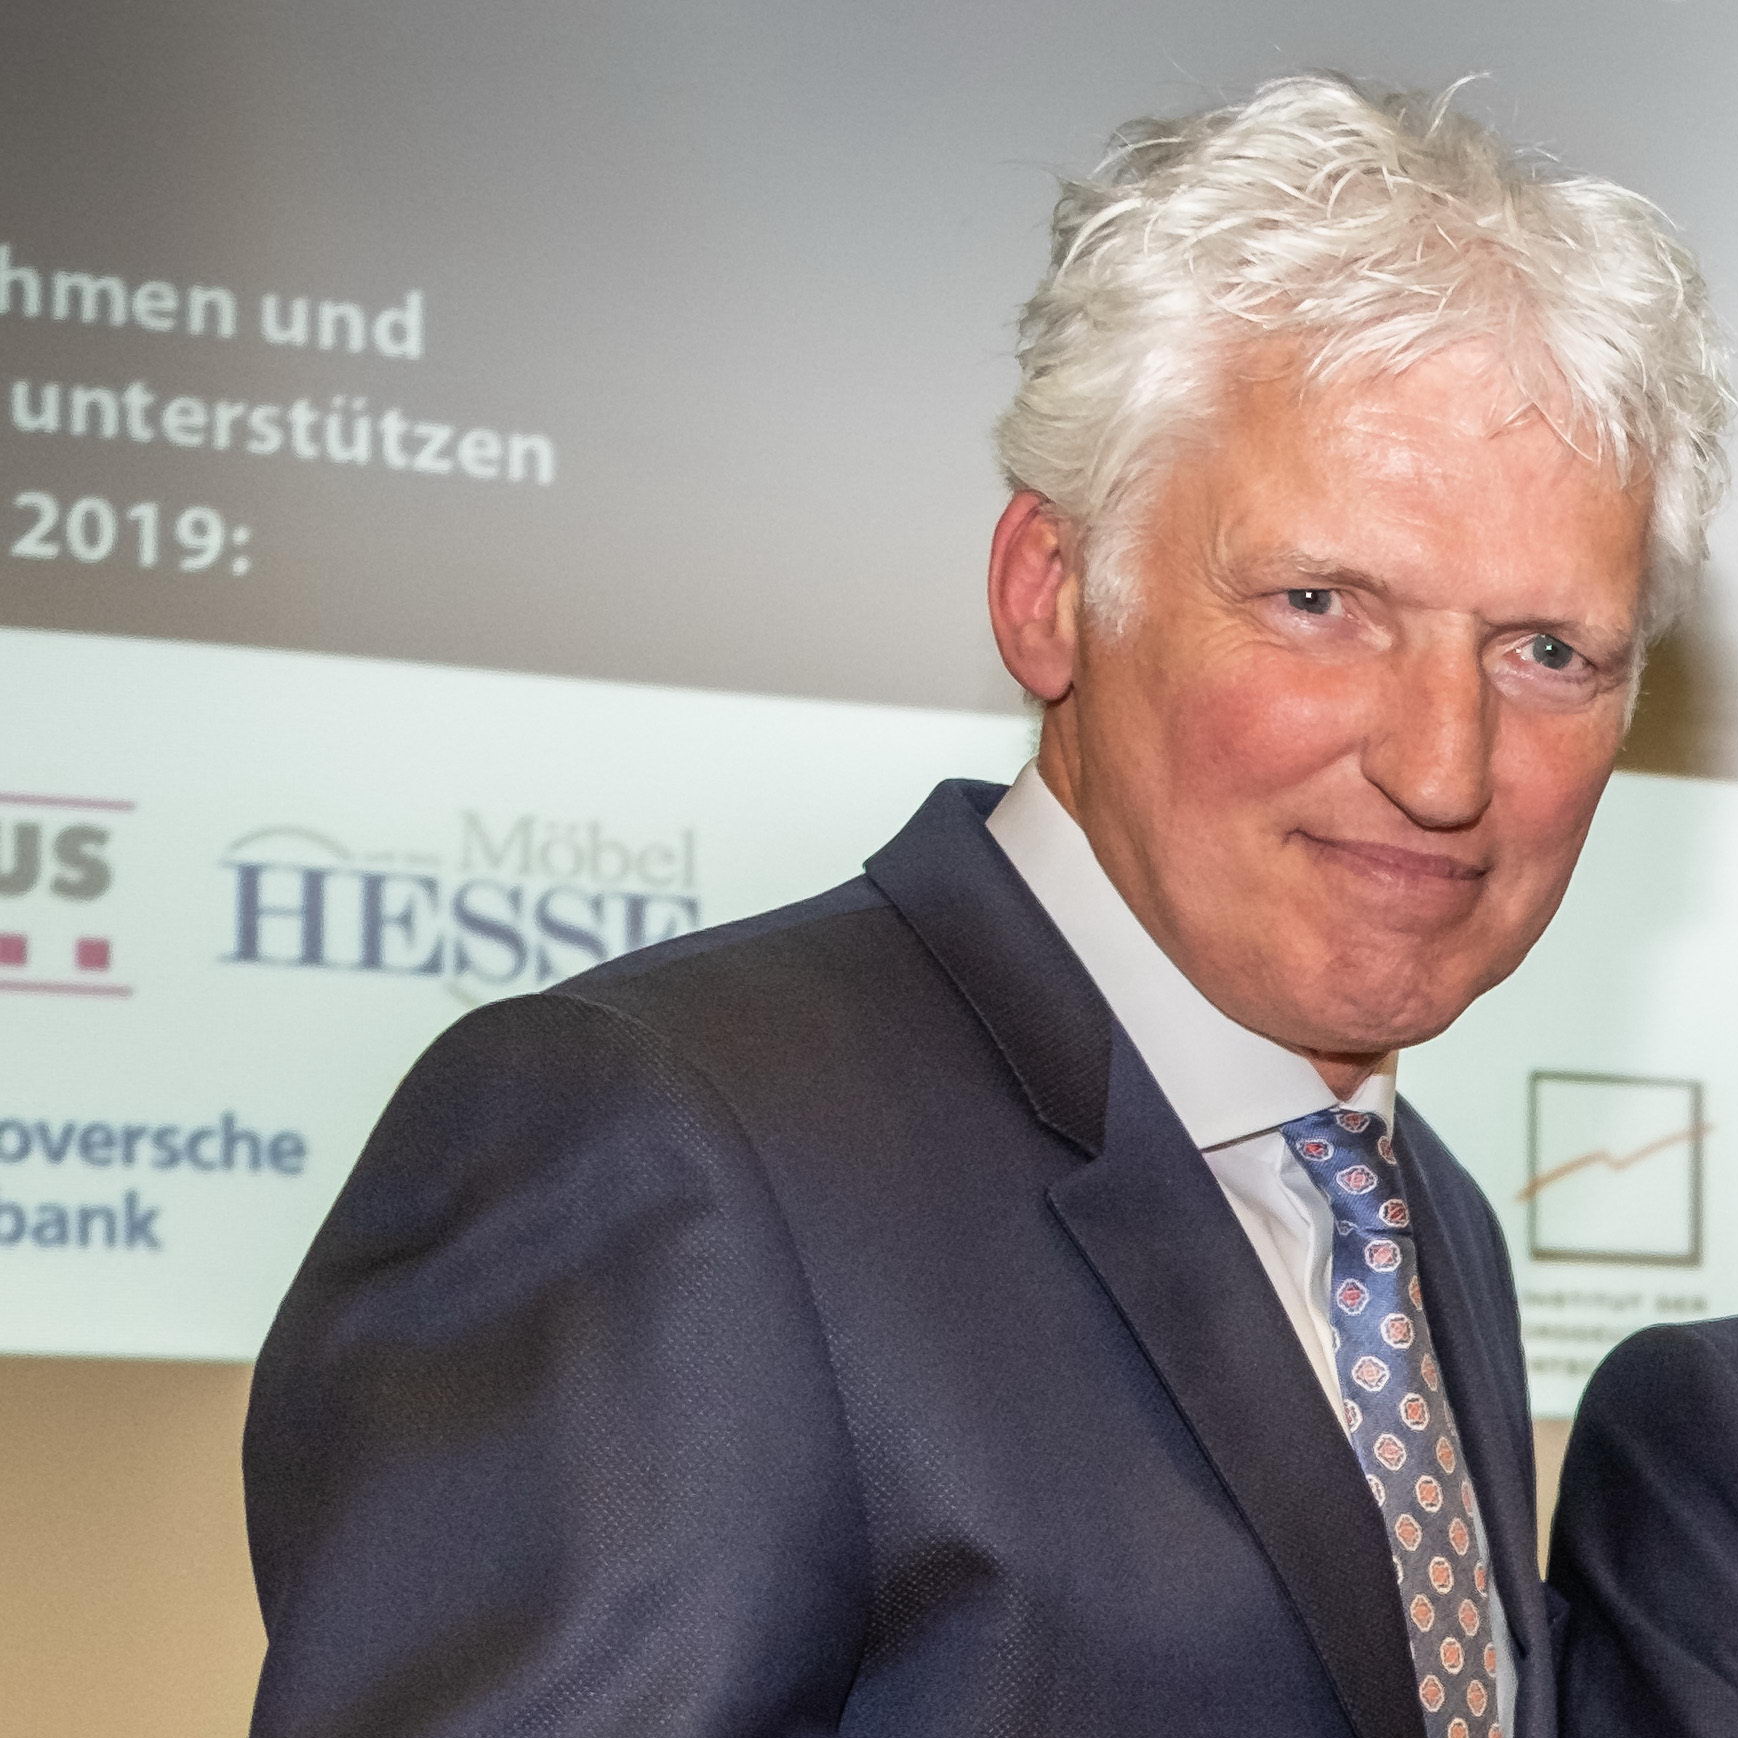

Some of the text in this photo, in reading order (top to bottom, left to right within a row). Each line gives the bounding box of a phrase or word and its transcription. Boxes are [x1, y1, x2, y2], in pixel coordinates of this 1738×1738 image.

[0, 243, 425, 360] hmen und
[11, 380, 556, 486] unterstützen
[11, 491, 252, 576] 2019:
[460, 809, 697, 889] Möbel
[0, 1108, 306, 1176] oversche
